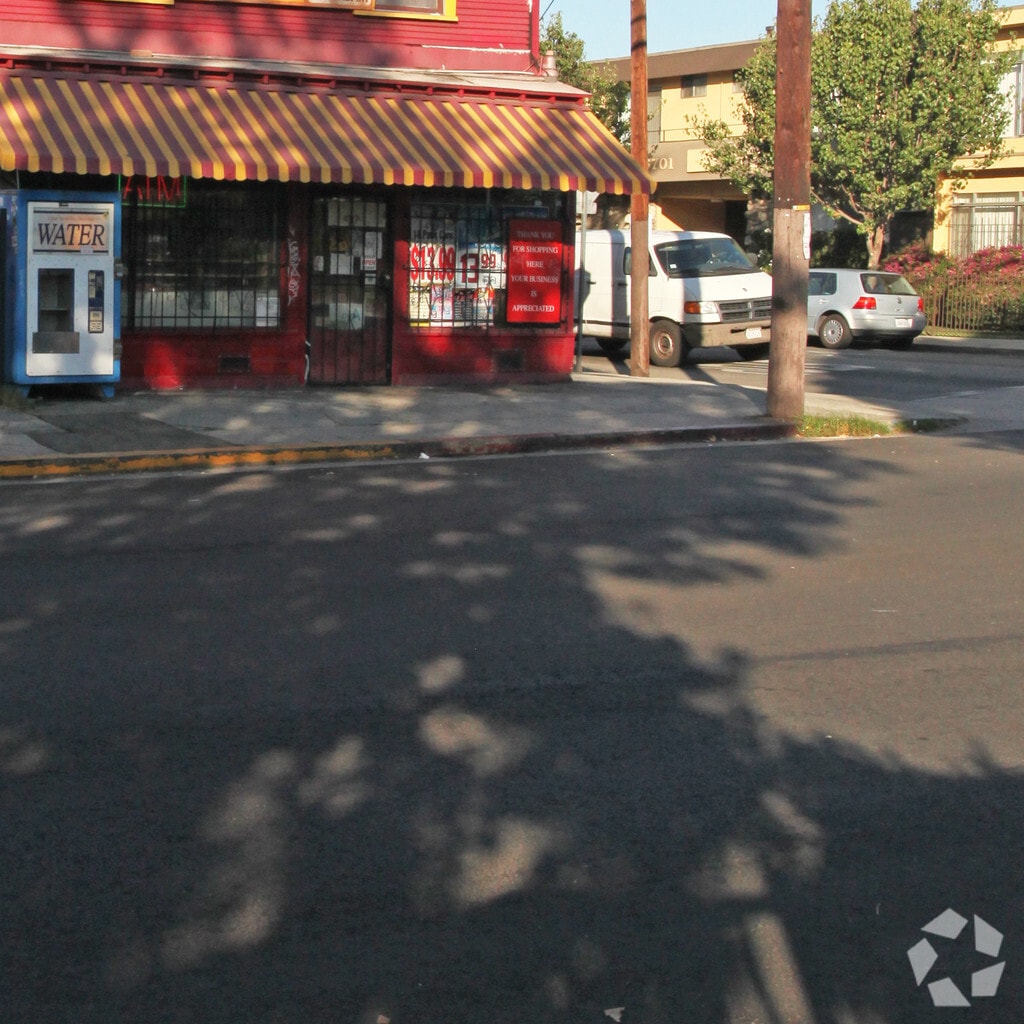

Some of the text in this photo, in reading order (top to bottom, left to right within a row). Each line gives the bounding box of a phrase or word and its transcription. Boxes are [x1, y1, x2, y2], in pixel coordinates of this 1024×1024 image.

[37, 222, 105, 246] WATER
[516, 230, 554, 239] THANK YOU
[512, 245, 558, 254] FOR SHOPPING
[526, 260, 544, 268] HERE
[511, 275, 559, 284] YOUR BUSINESS
[512, 304, 555, 313] APPRECIATED
